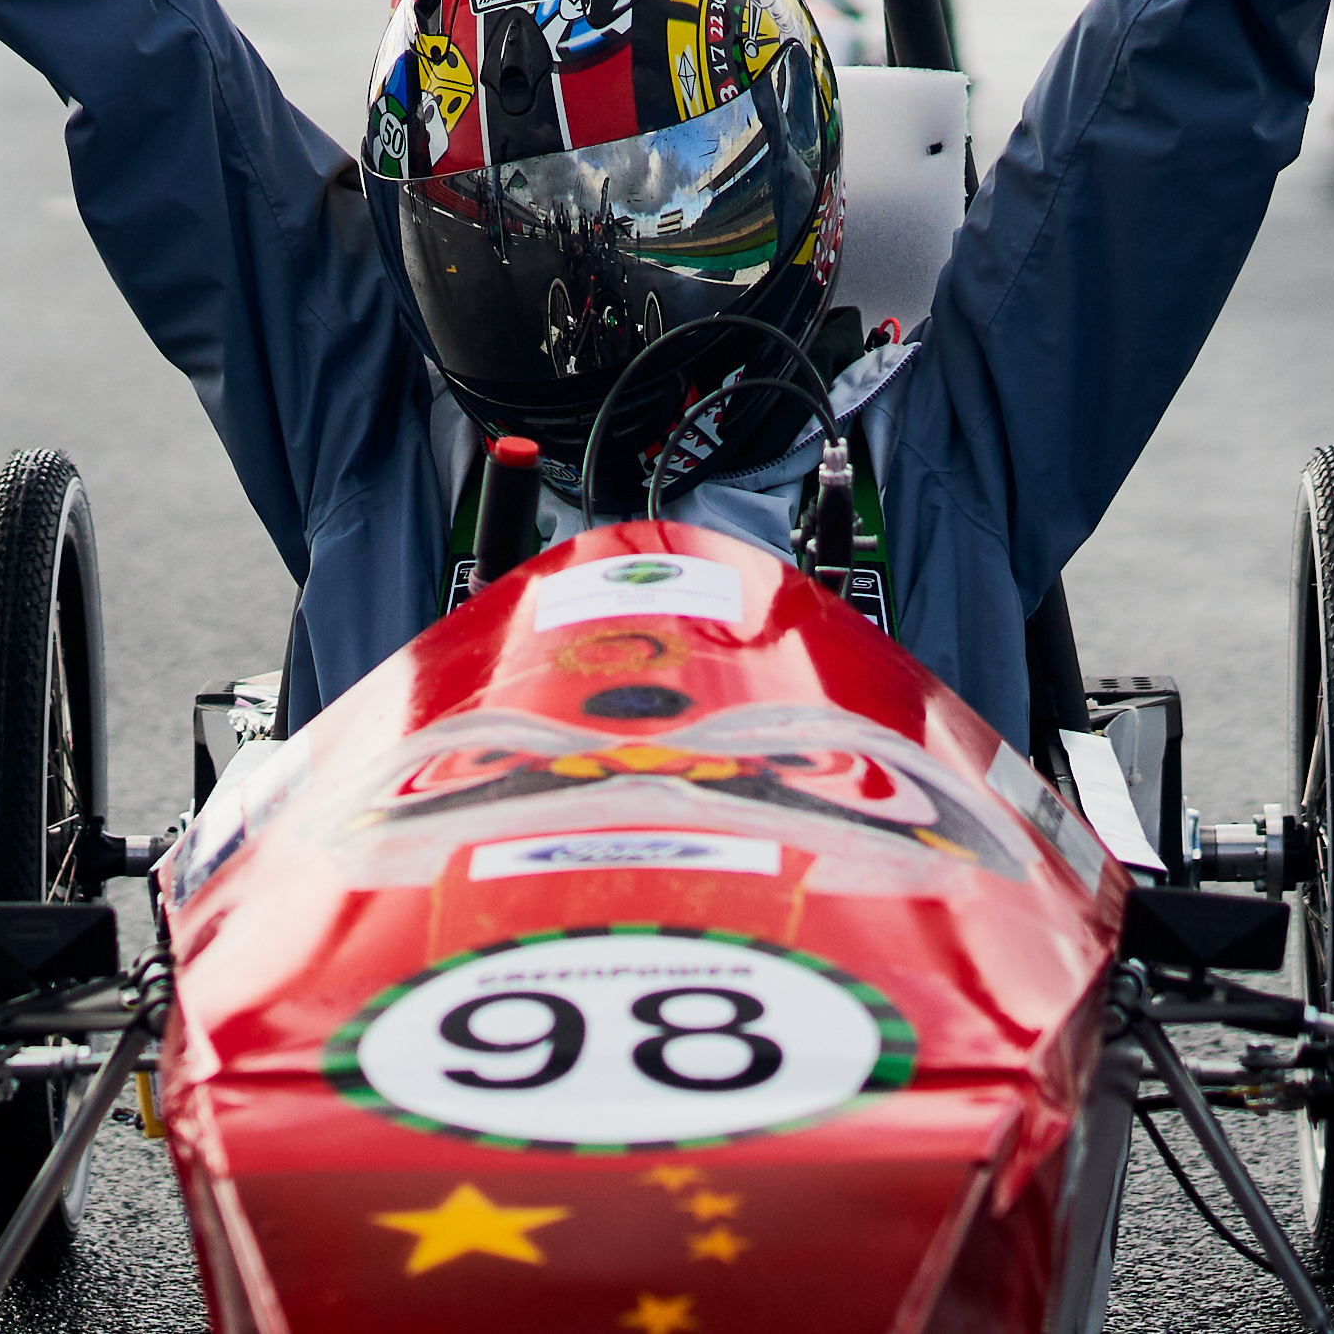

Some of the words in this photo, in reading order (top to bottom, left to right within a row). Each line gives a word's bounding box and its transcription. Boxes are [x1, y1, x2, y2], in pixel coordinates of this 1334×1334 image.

[710, 16, 725, 38] 22
[710, 46, 729, 74] 17
[383, 118, 404, 155] 50
[440, 987, 784, 1092] 98
